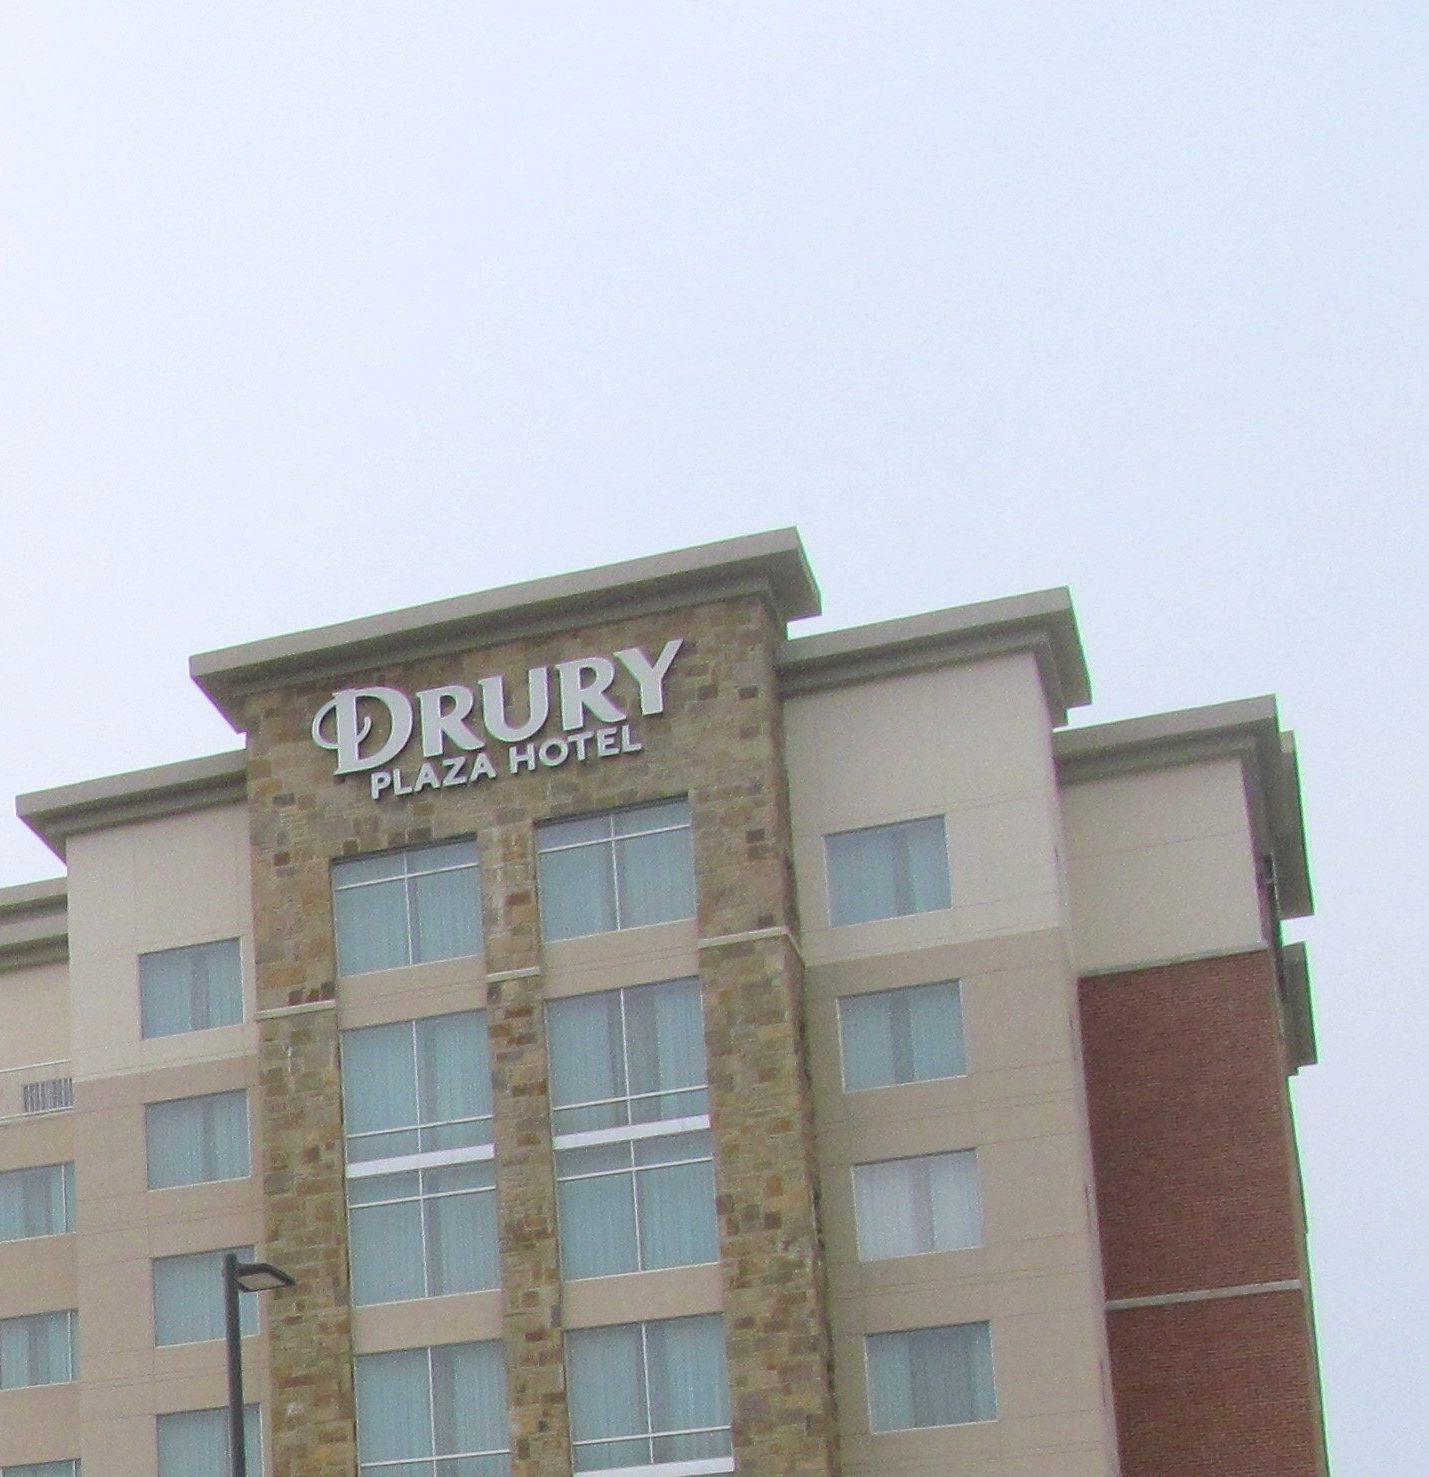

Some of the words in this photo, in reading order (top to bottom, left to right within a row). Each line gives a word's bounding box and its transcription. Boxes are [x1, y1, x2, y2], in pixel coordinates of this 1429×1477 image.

[312, 639, 684, 775] DRURY
[371, 753, 497, 800] PLAZA
[508, 725, 642, 774] HOTEL
